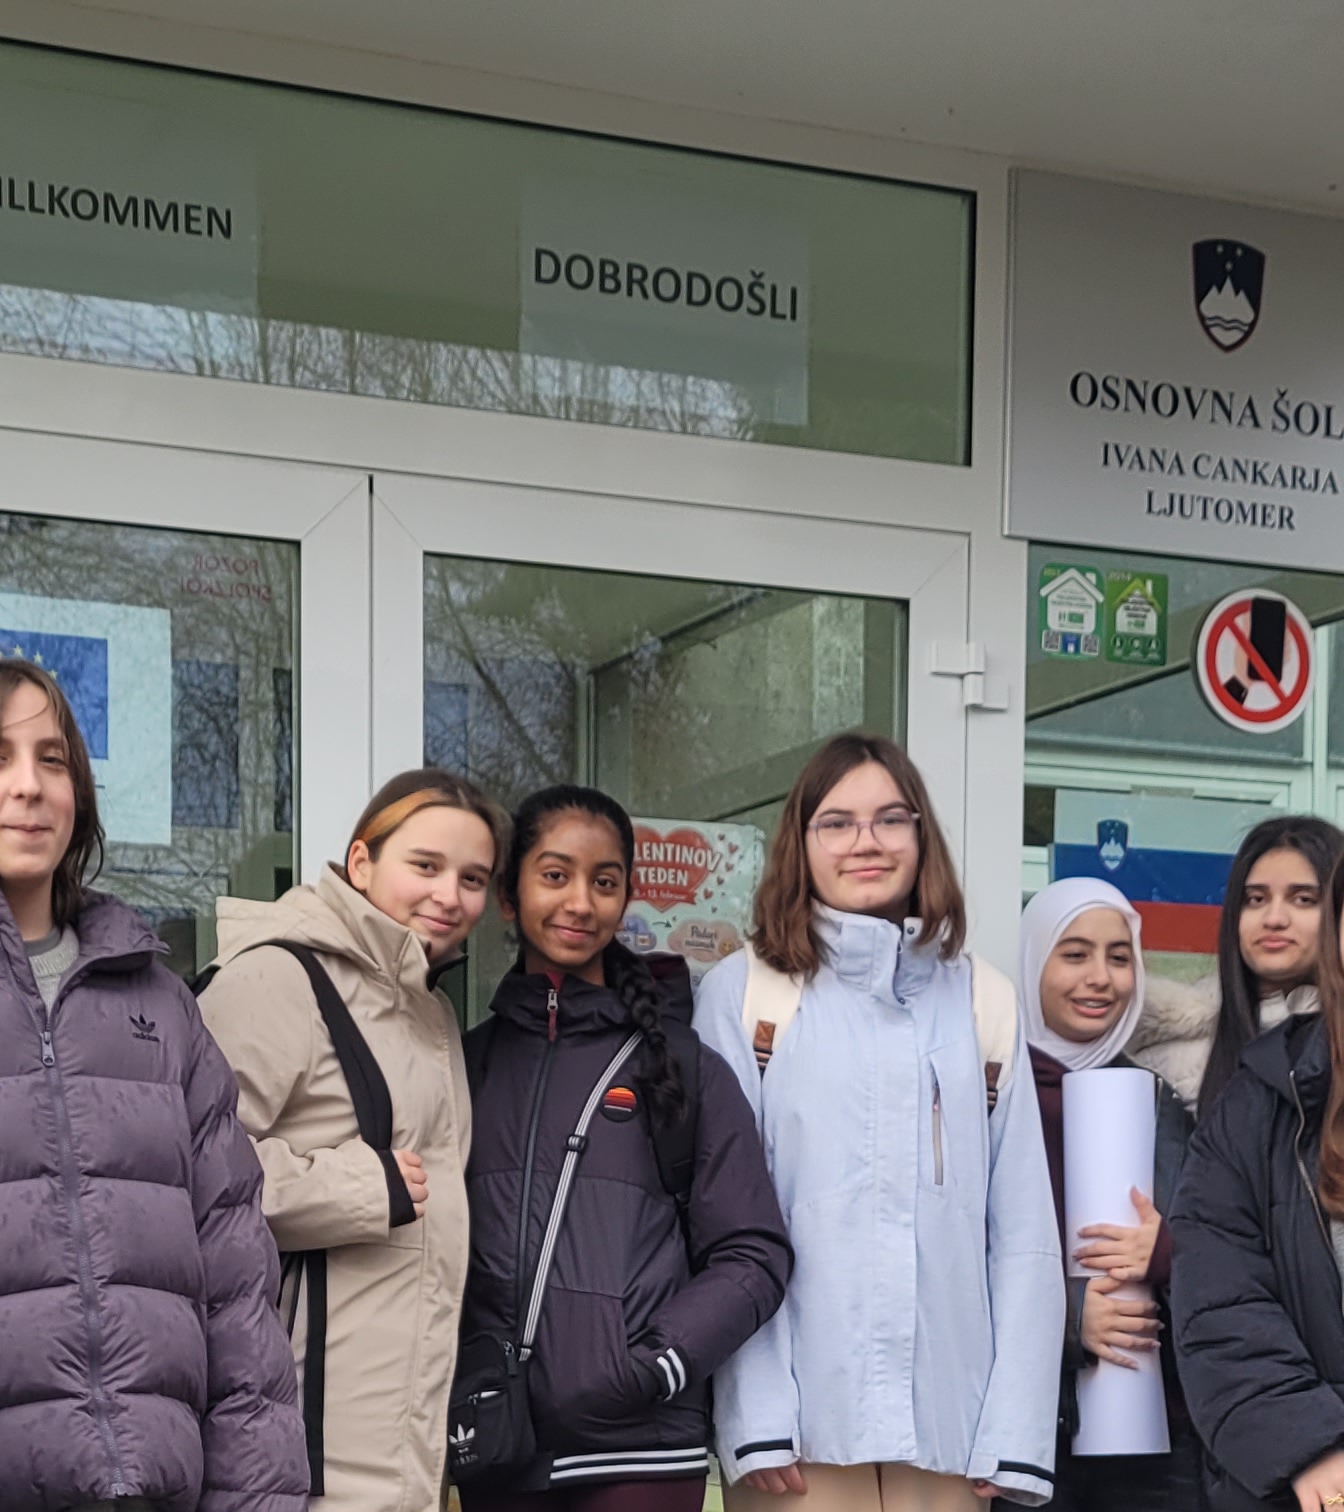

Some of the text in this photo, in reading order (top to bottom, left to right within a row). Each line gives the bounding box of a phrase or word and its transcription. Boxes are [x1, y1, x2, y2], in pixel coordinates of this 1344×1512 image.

[534, 247, 798, 322] DOBRODOŠLI
[1069, 371, 1261, 429] OSNOVNA
[1101, 442, 1340, 495] IVANA CANKARJA
[1145, 489, 1296, 531] LJUTOMER
[634, 841, 722, 872] LENTINOV
[636, 866, 689, 887] TEDEN
